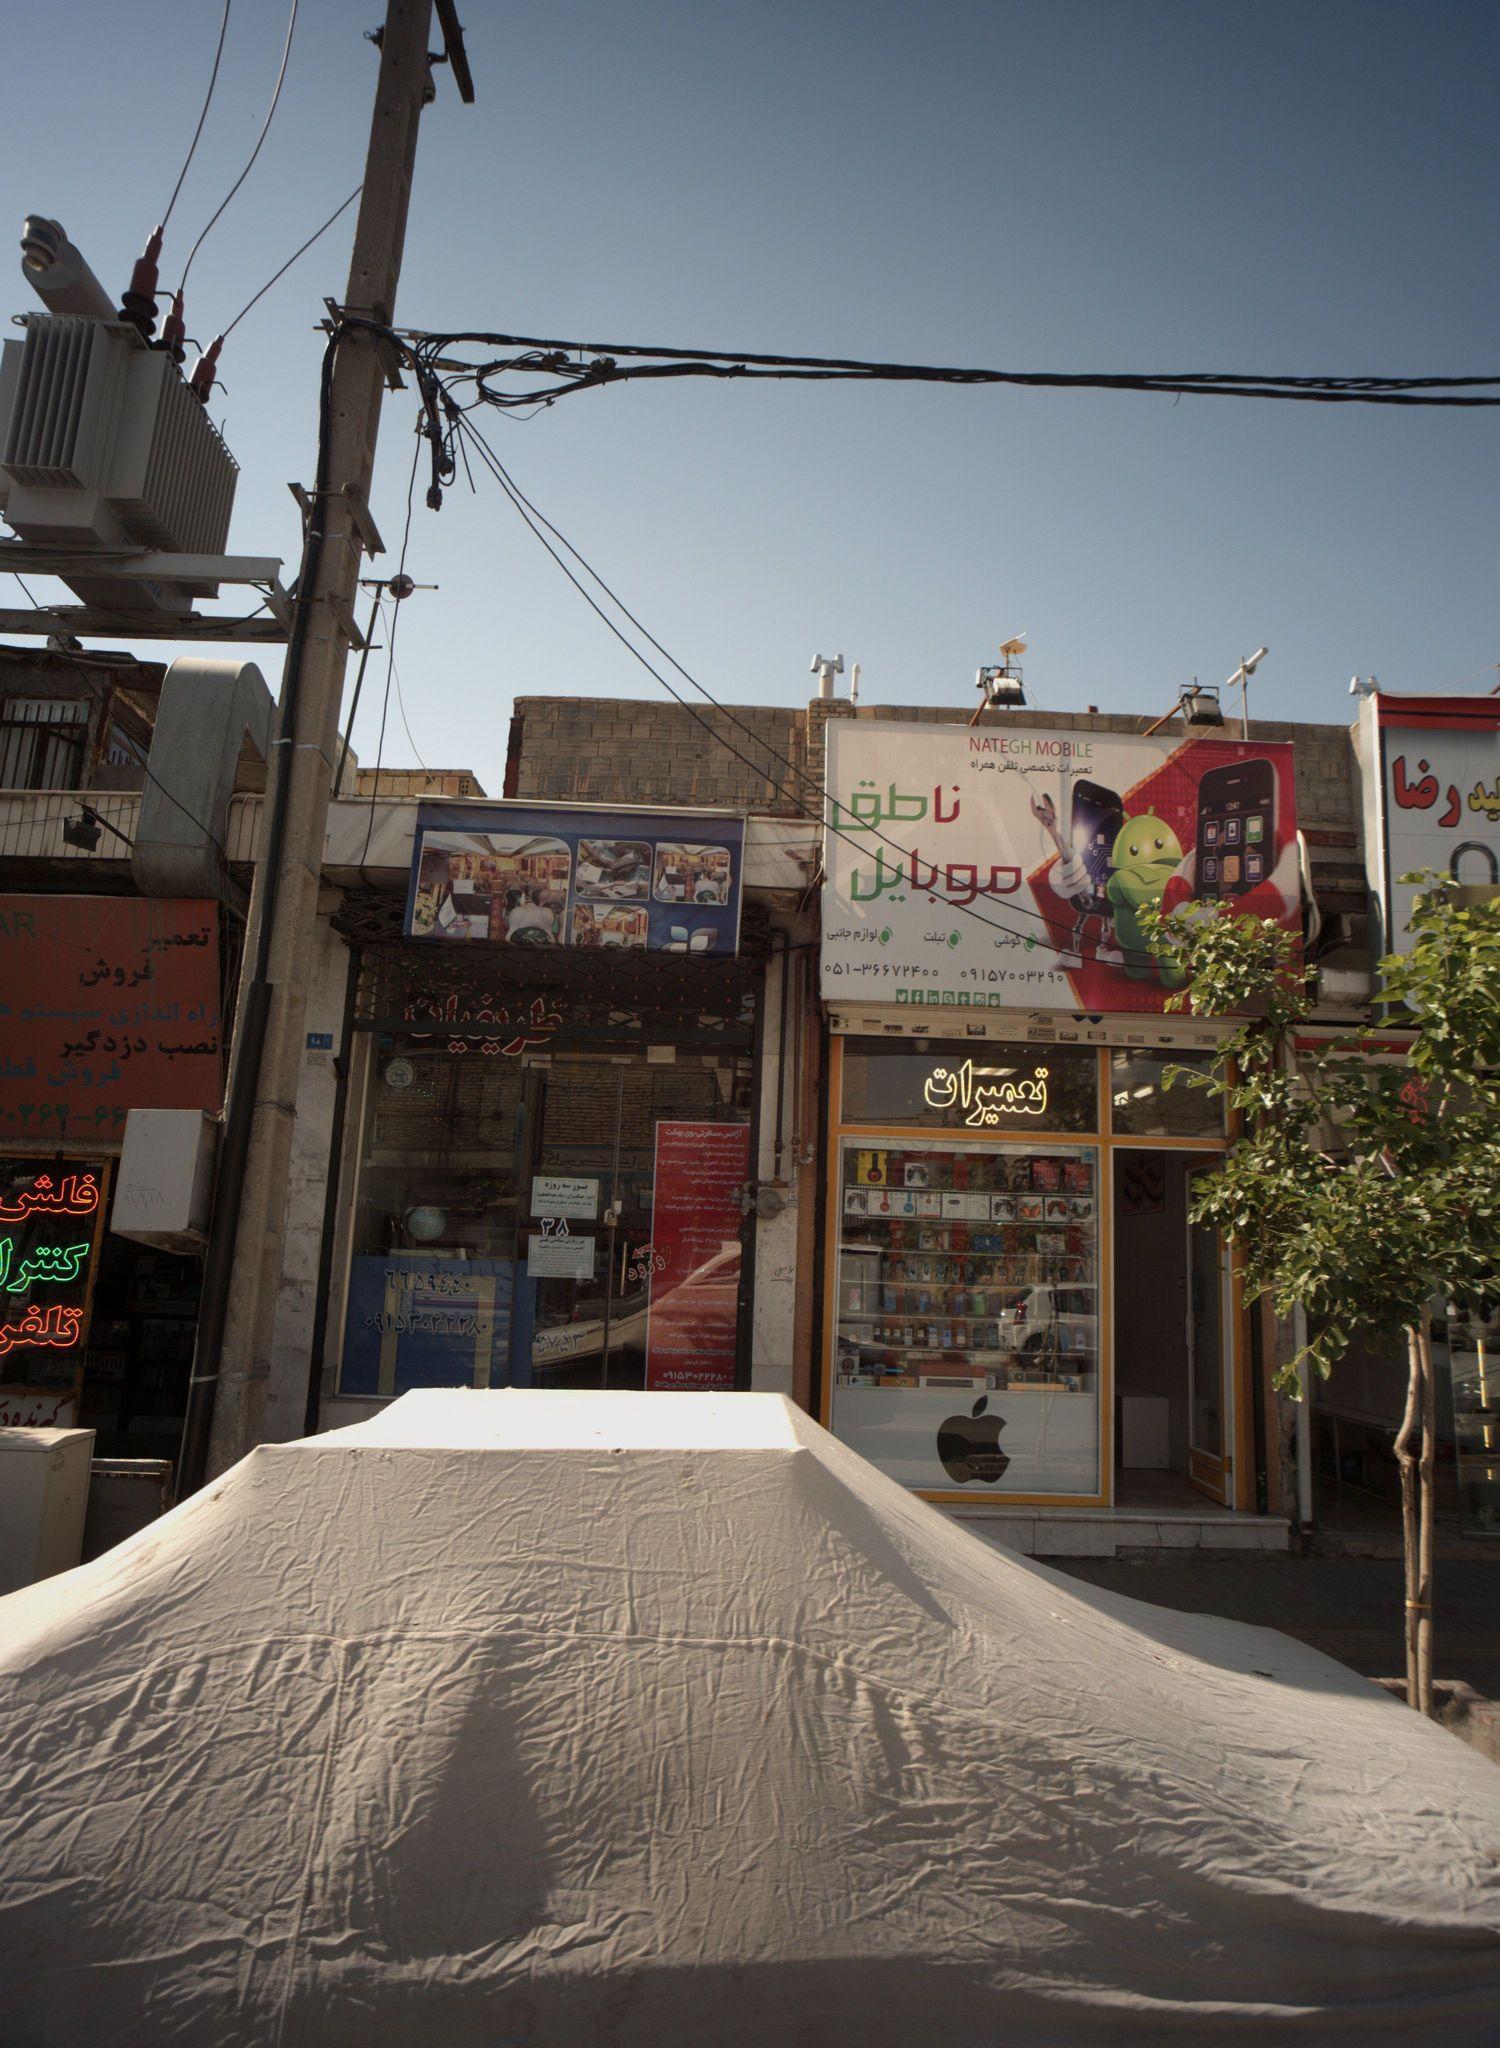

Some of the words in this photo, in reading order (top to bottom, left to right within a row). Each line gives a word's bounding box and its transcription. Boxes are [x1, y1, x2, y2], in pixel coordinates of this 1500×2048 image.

[969, 735, 1032, 754] NATEGH
[1035, 740, 1093, 758] MOBILE
[970, 758, 996, 772] همراه
[997, 760, 1019, 773] تلفن
[1019, 762, 1055, 774] تخصصی
[1056, 763, 1093, 777] تعمیرات
[1392, 754, 1462, 828] رضا
[832, 780, 962, 832] ناطق
[850, 846, 1022, 906] موبایل
[141, 927, 212, 953] تعمیر
[826, 926, 852, 942] جانبی
[852, 927, 879, 944] لوازم
[923, 931, 947, 944] تبلت
[993, 934, 1021, 949] گوشی
[79, 957, 153, 987] فروش
[960, 969, 1065, 983] ۰۹۱۵۷۰۰۳۲۹۰
[20, 1000, 102, 1024] سیستم
[107, 1001, 181, 1027] اندازی
[187, 1002, 218, 1029] راه
[59, 1029, 148, 1059] دزدگیر
[157, 1036, 219, 1060] نصب
[47, 1060, 122, 1088] فروش
[923, 1057, 1049, 1127] تعمیرات
[540, 1217, 570, 1237] ۳۸
[627, 1254, 667, 1282] ورود
